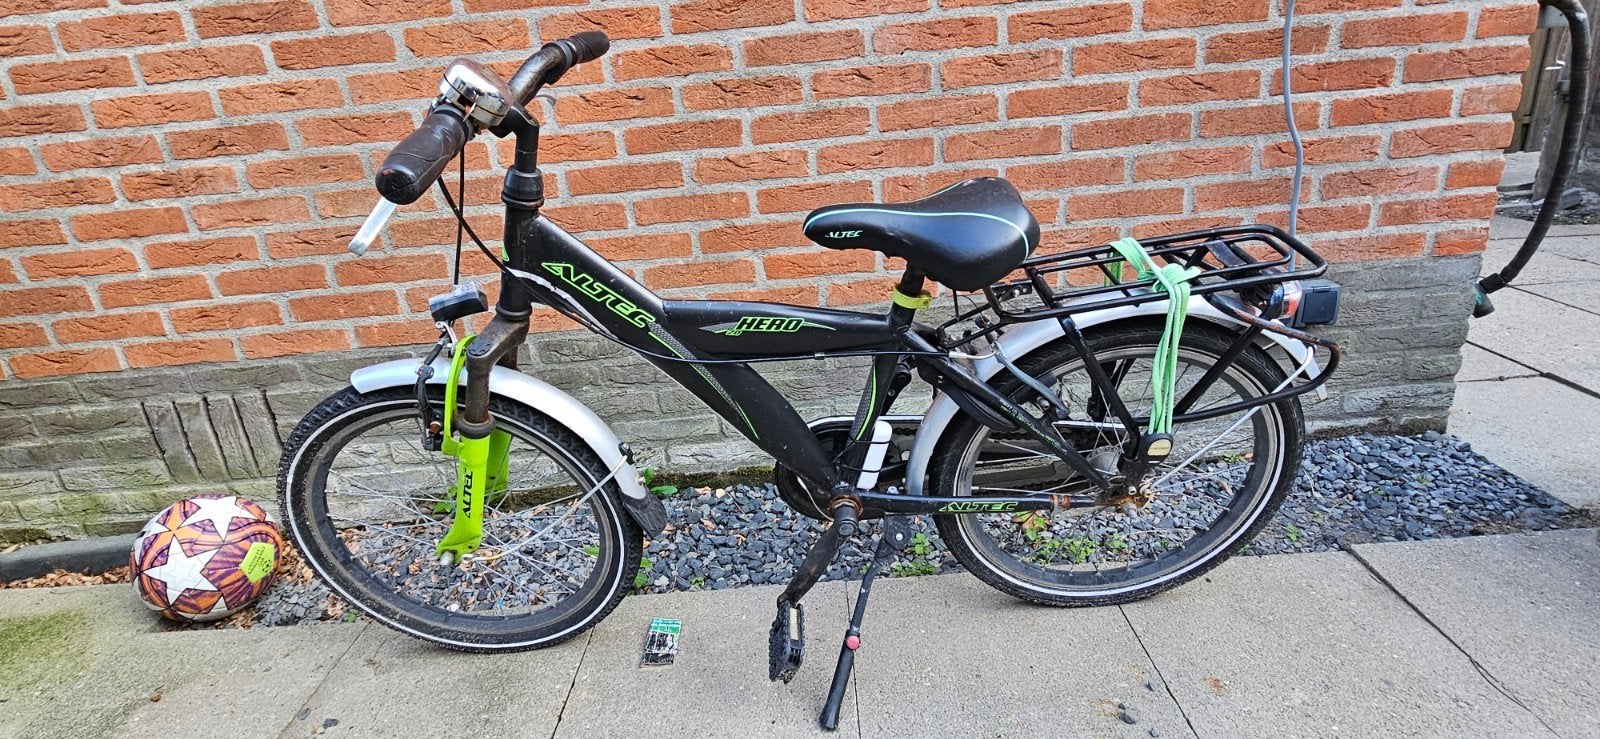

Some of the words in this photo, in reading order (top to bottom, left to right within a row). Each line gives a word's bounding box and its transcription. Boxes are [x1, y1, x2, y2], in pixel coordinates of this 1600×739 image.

[824, 230, 863, 239] ALTEC
[541, 262, 656, 328] ALTEC
[735, 316, 805, 333] HERO
[939, 501, 1019, 512] ALTEC
